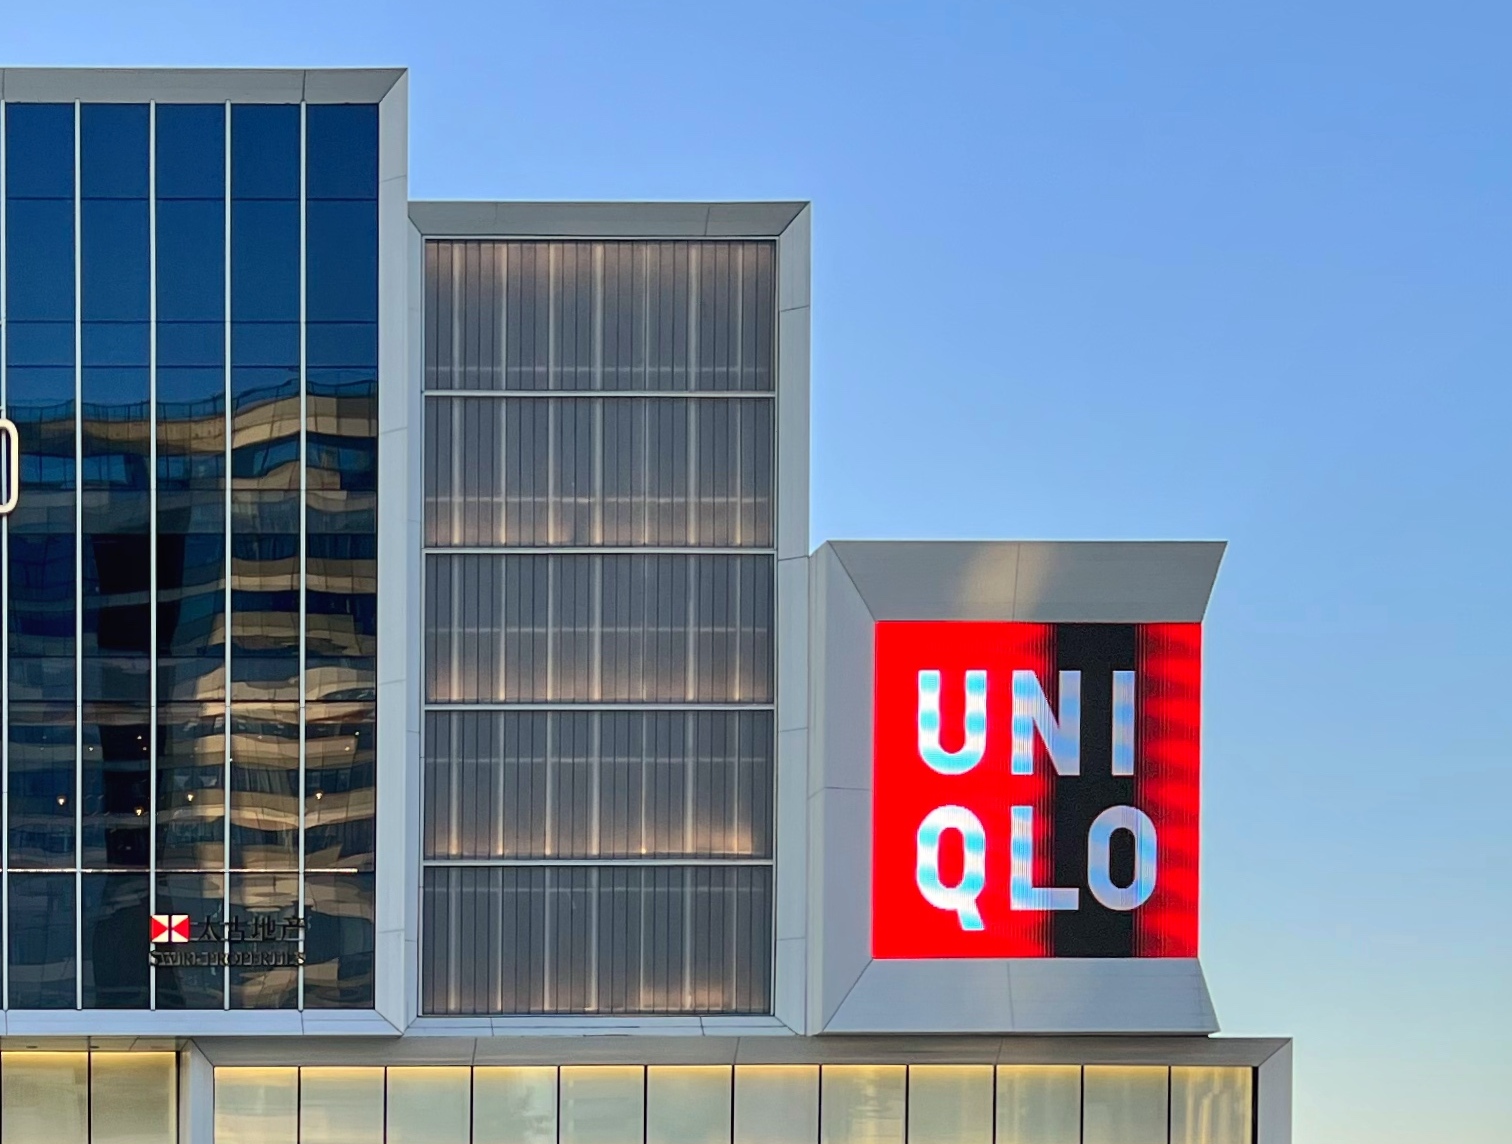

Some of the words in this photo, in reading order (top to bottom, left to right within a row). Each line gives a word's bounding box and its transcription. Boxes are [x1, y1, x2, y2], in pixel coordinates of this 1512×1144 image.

[917, 669, 1137, 776] UNI
[915, 804, 1158, 931] QLO
[197, 914, 306, 943] 太古地产
